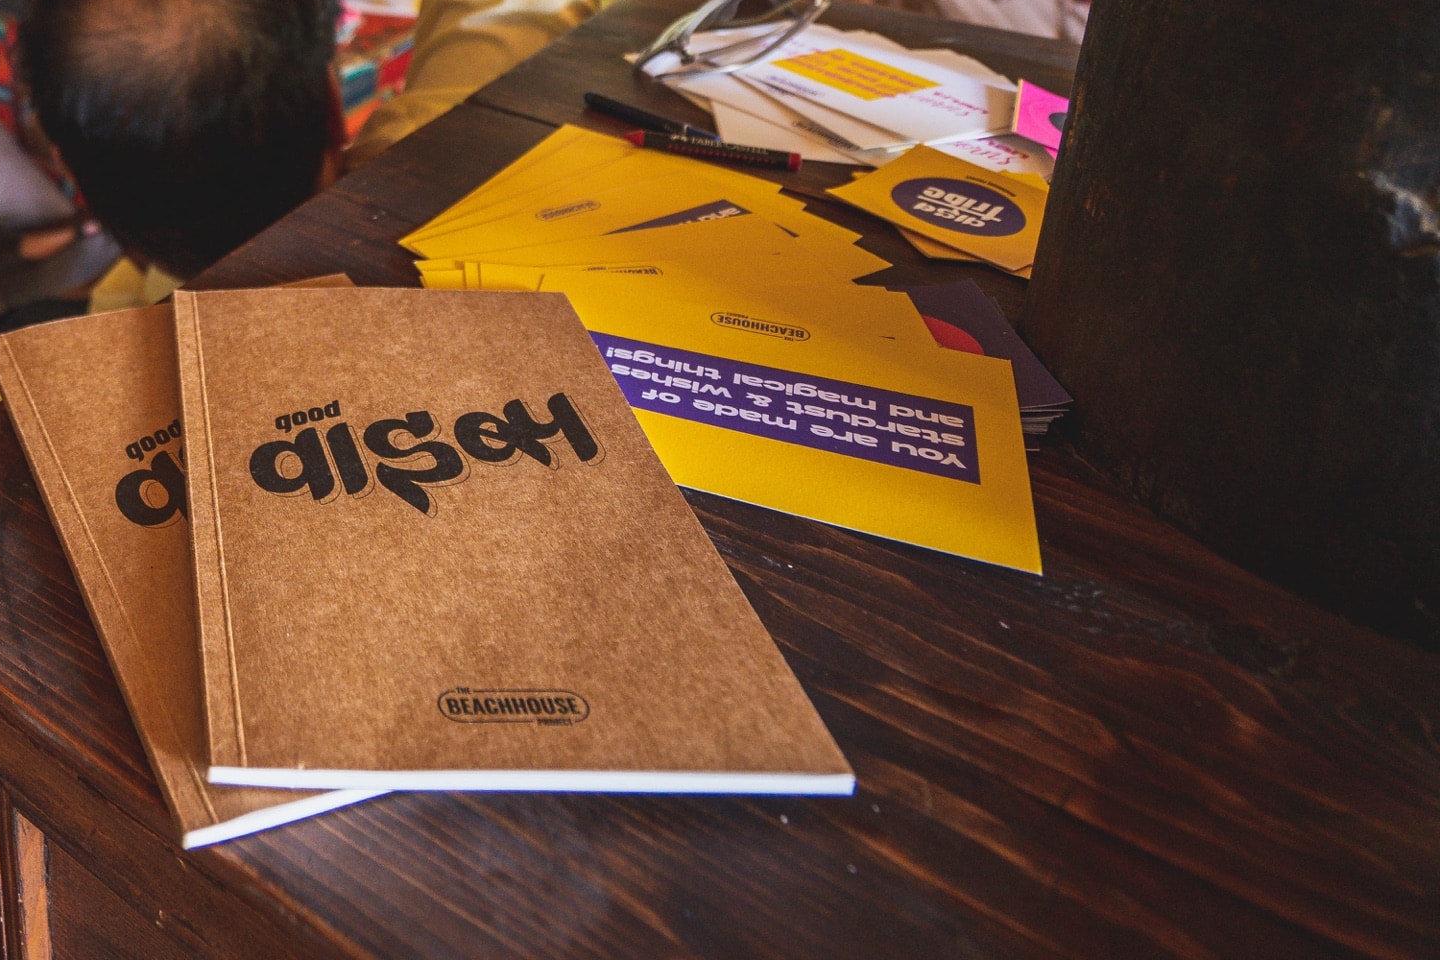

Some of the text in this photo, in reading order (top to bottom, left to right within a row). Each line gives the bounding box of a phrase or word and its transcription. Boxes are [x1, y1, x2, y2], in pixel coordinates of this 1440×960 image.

[917, 187, 1004, 222] tribe
[716, 315, 805, 338] BEACHHOUSE
[606, 347, 963, 427] and magical things!
[611, 364, 964, 445] stardust & wishes
[274, 401, 341, 433] good
[642, 388, 965, 468] You are made of
[125, 419, 182, 461] good
[446, 696, 580, 716] BEACHHOUSE
[456, 687, 471, 695] THE
